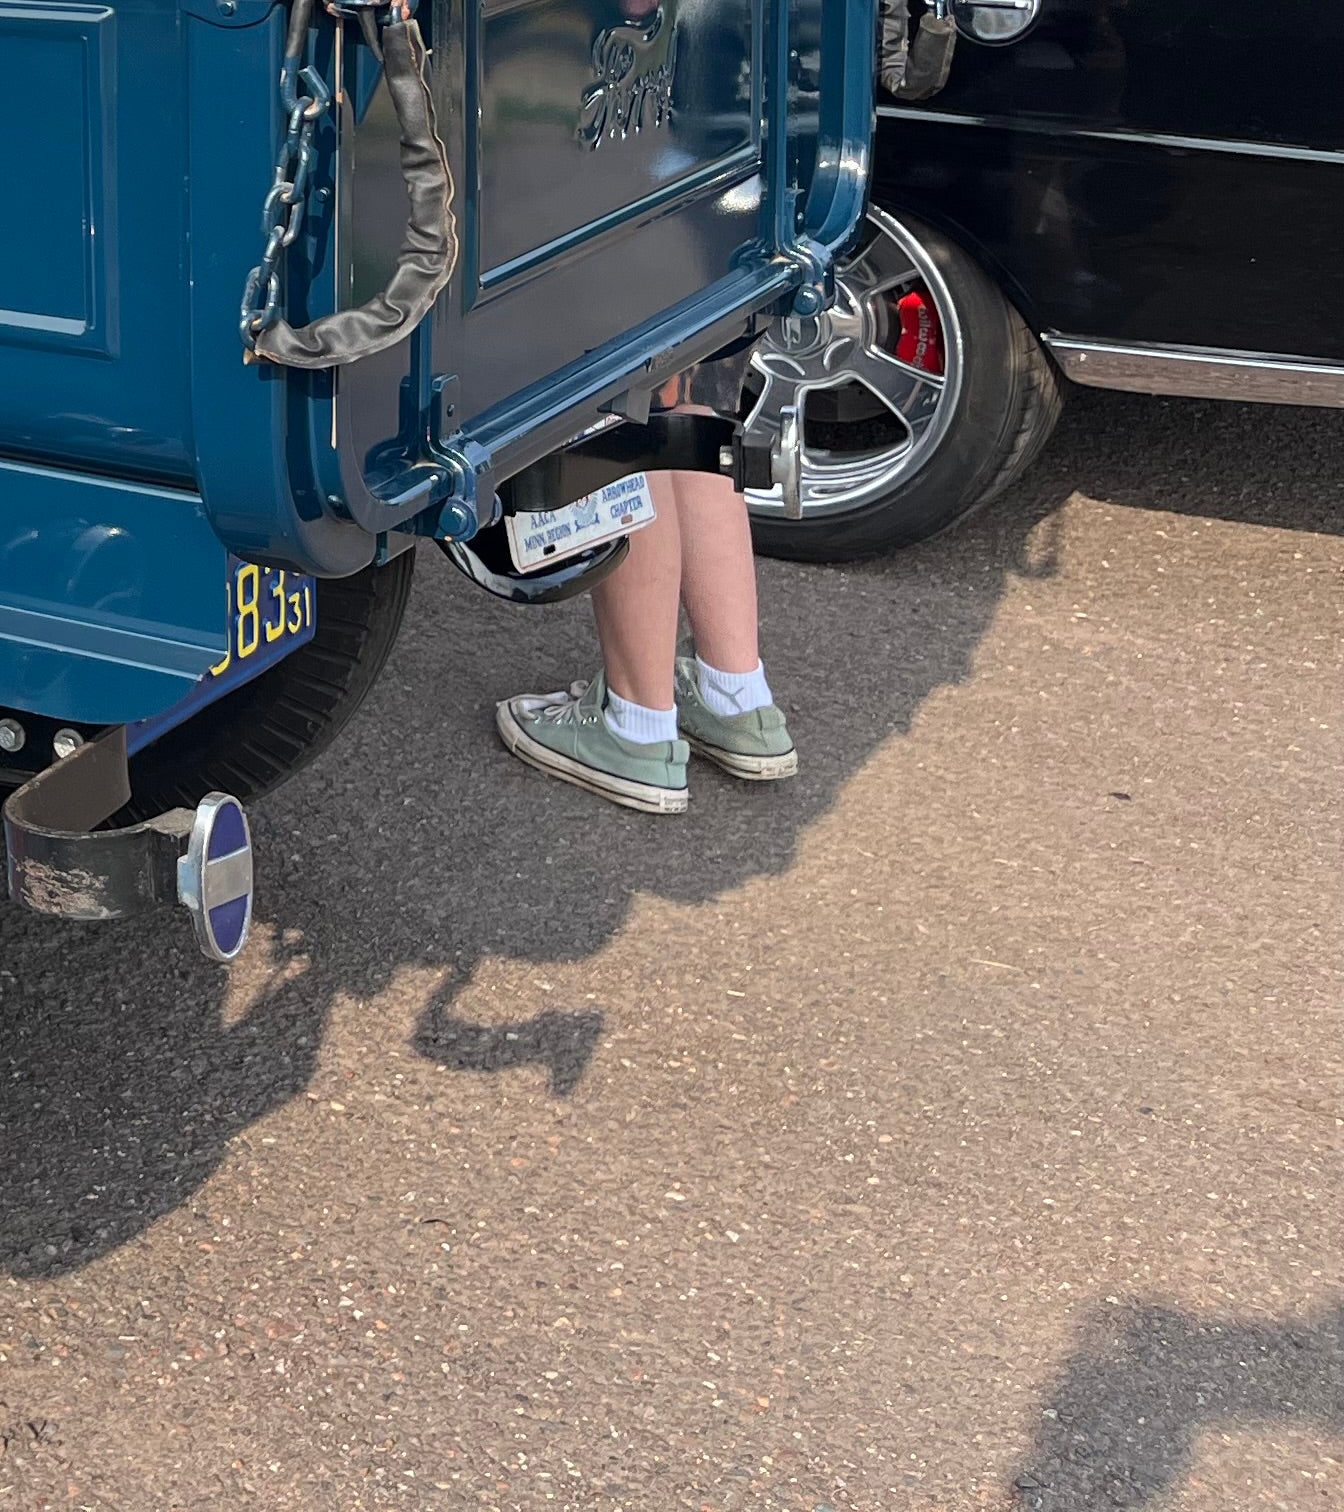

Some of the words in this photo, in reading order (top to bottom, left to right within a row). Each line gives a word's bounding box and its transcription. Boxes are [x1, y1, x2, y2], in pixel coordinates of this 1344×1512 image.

[601, 474, 645, 503] ARROWHEAD
[610, 495, 644, 519] CHAPTER
[530, 511, 557, 530] AACA
[547, 522, 572, 543] REGION
[288, 586, 311, 634] 31
